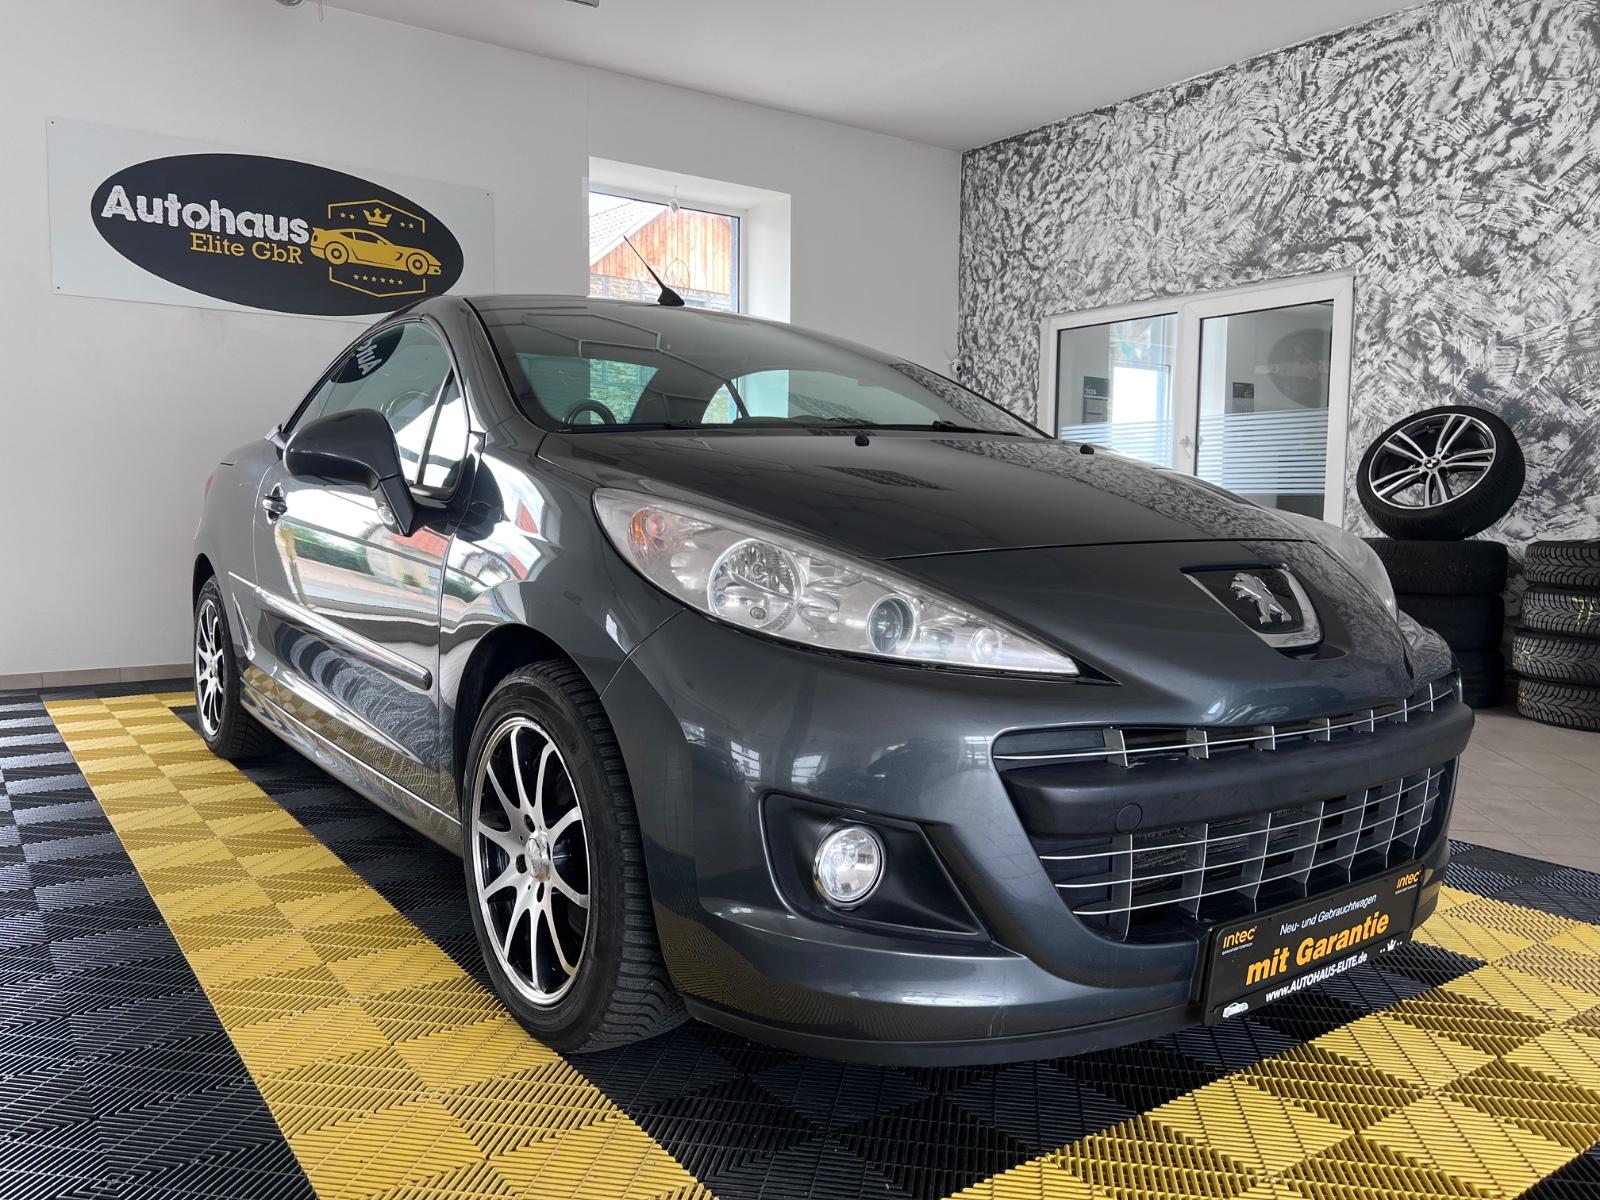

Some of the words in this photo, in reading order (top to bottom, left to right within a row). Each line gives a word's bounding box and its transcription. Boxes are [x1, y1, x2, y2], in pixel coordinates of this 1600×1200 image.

[101, 184, 310, 244] Autohaus
[190, 232, 245, 257] Elite
[252, 241, 303, 264] GbR
[1223, 927, 1256, 949] intec
[1279, 922, 1300, 936] Neu-
[1301, 914, 1318, 929] und
[1317, 894, 1377, 923] Gebrauchtwagen
[1245, 946, 1290, 986] mit
[1296, 911, 1390, 966] Garantie
[1265, 951, 1368, 1003] www.AUTOHAUS-ELITE.de
